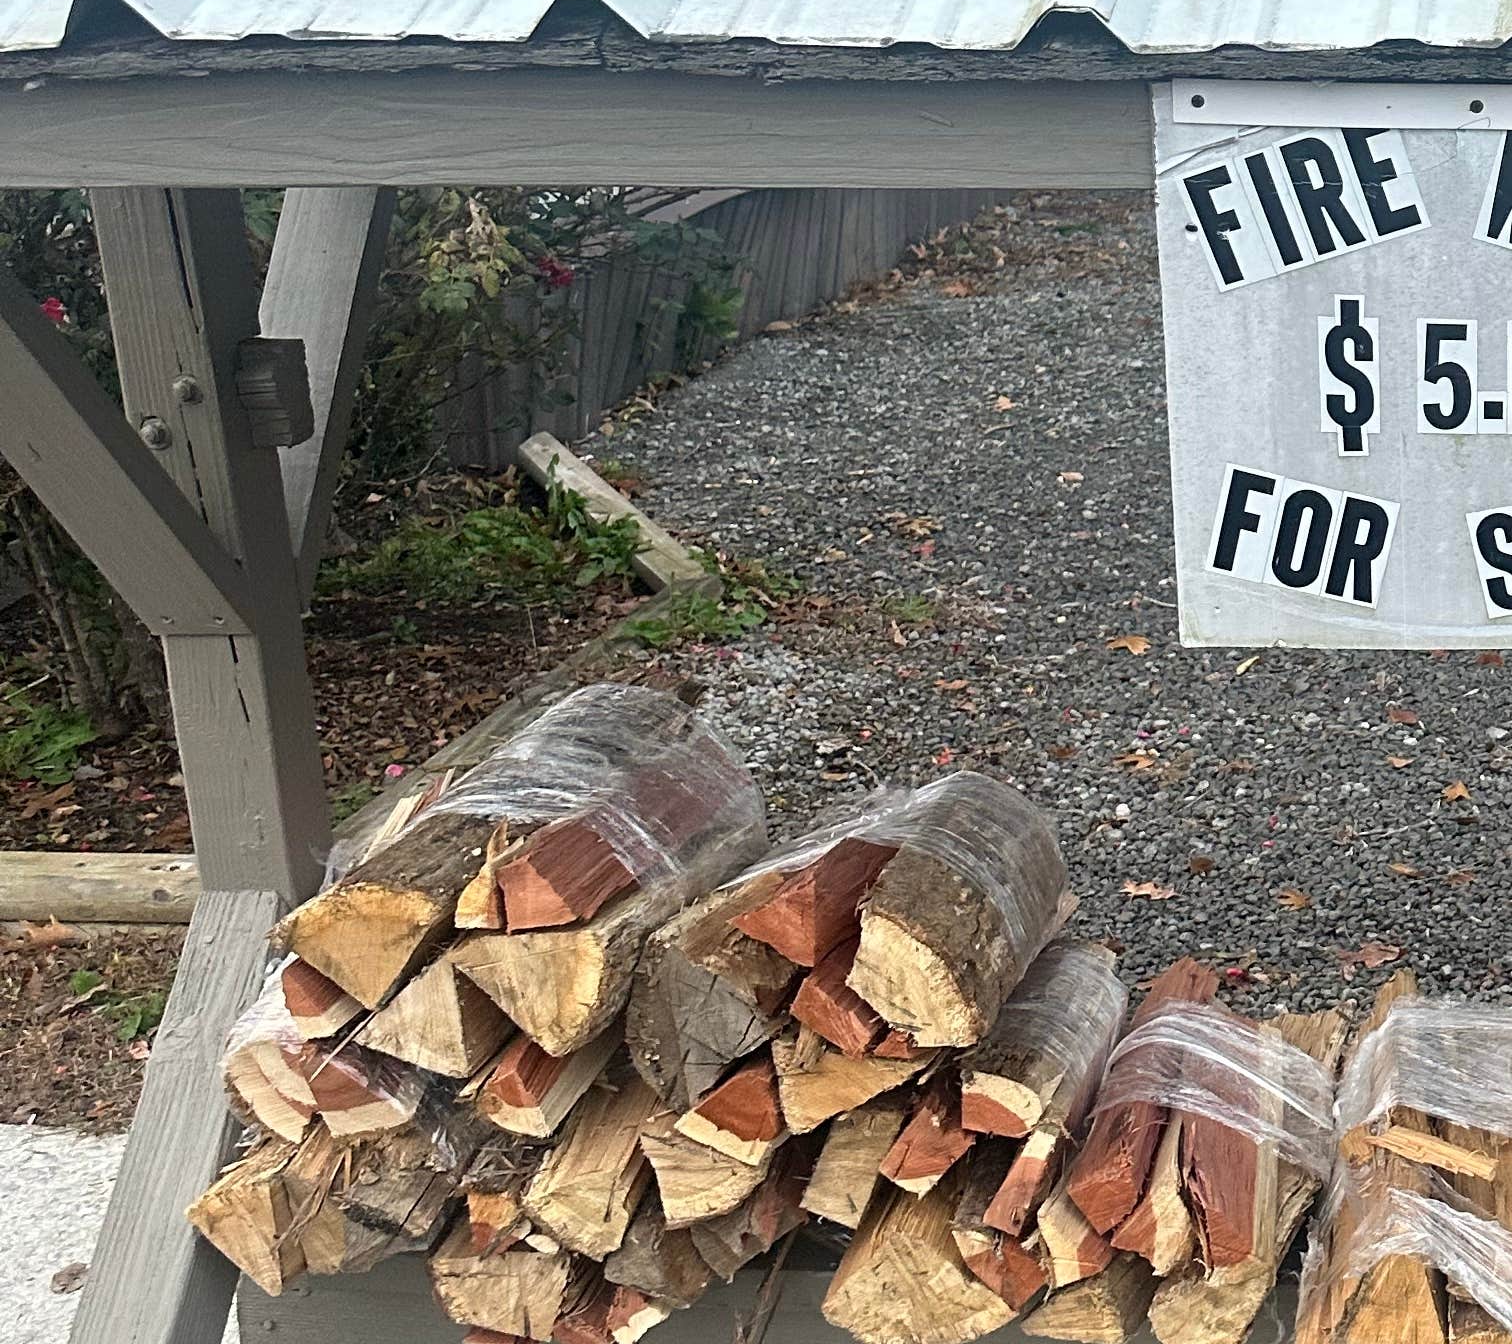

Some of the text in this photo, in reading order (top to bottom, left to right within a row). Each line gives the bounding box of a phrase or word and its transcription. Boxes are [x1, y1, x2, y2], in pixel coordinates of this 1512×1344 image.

[1183, 128, 1422, 285] FIRE
[1324, 299, 1374, 452] $
[1212, 468, 1390, 604] FOR
